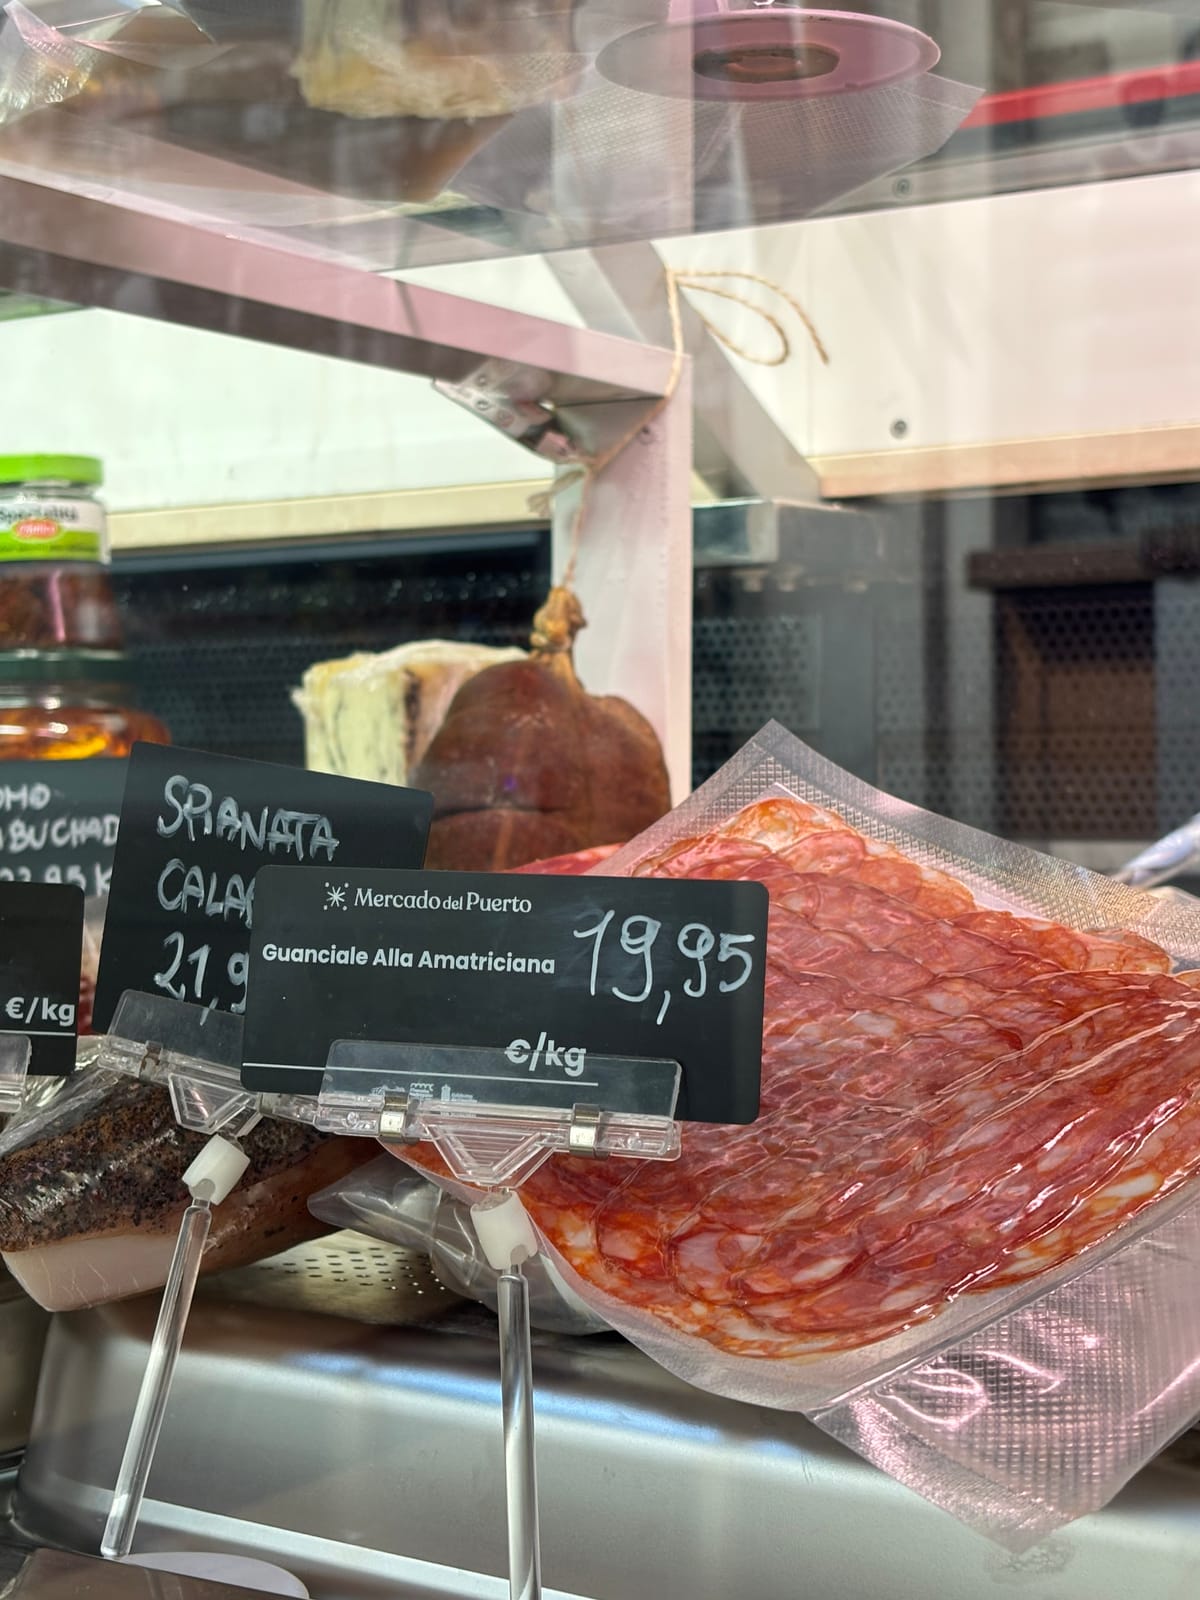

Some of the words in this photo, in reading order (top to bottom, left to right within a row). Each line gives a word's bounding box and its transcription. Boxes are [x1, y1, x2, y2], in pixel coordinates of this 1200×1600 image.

[0, 813, 120, 854] BUCHAD
[157, 775, 340, 862] SPIANATA
[354, 888, 441, 910] Mercado
[443, 896, 463, 910] del
[466, 892, 532, 913] Puerto
[262, 943, 368, 965] Guanciale
[372, 948, 413, 967] Alla
[418, 950, 555, 974] Amatriciana
[573, 909, 755, 1025] 19,95
[5, 997, 75, 1026] €/kg
[504, 1031, 587, 1077] €/kg
